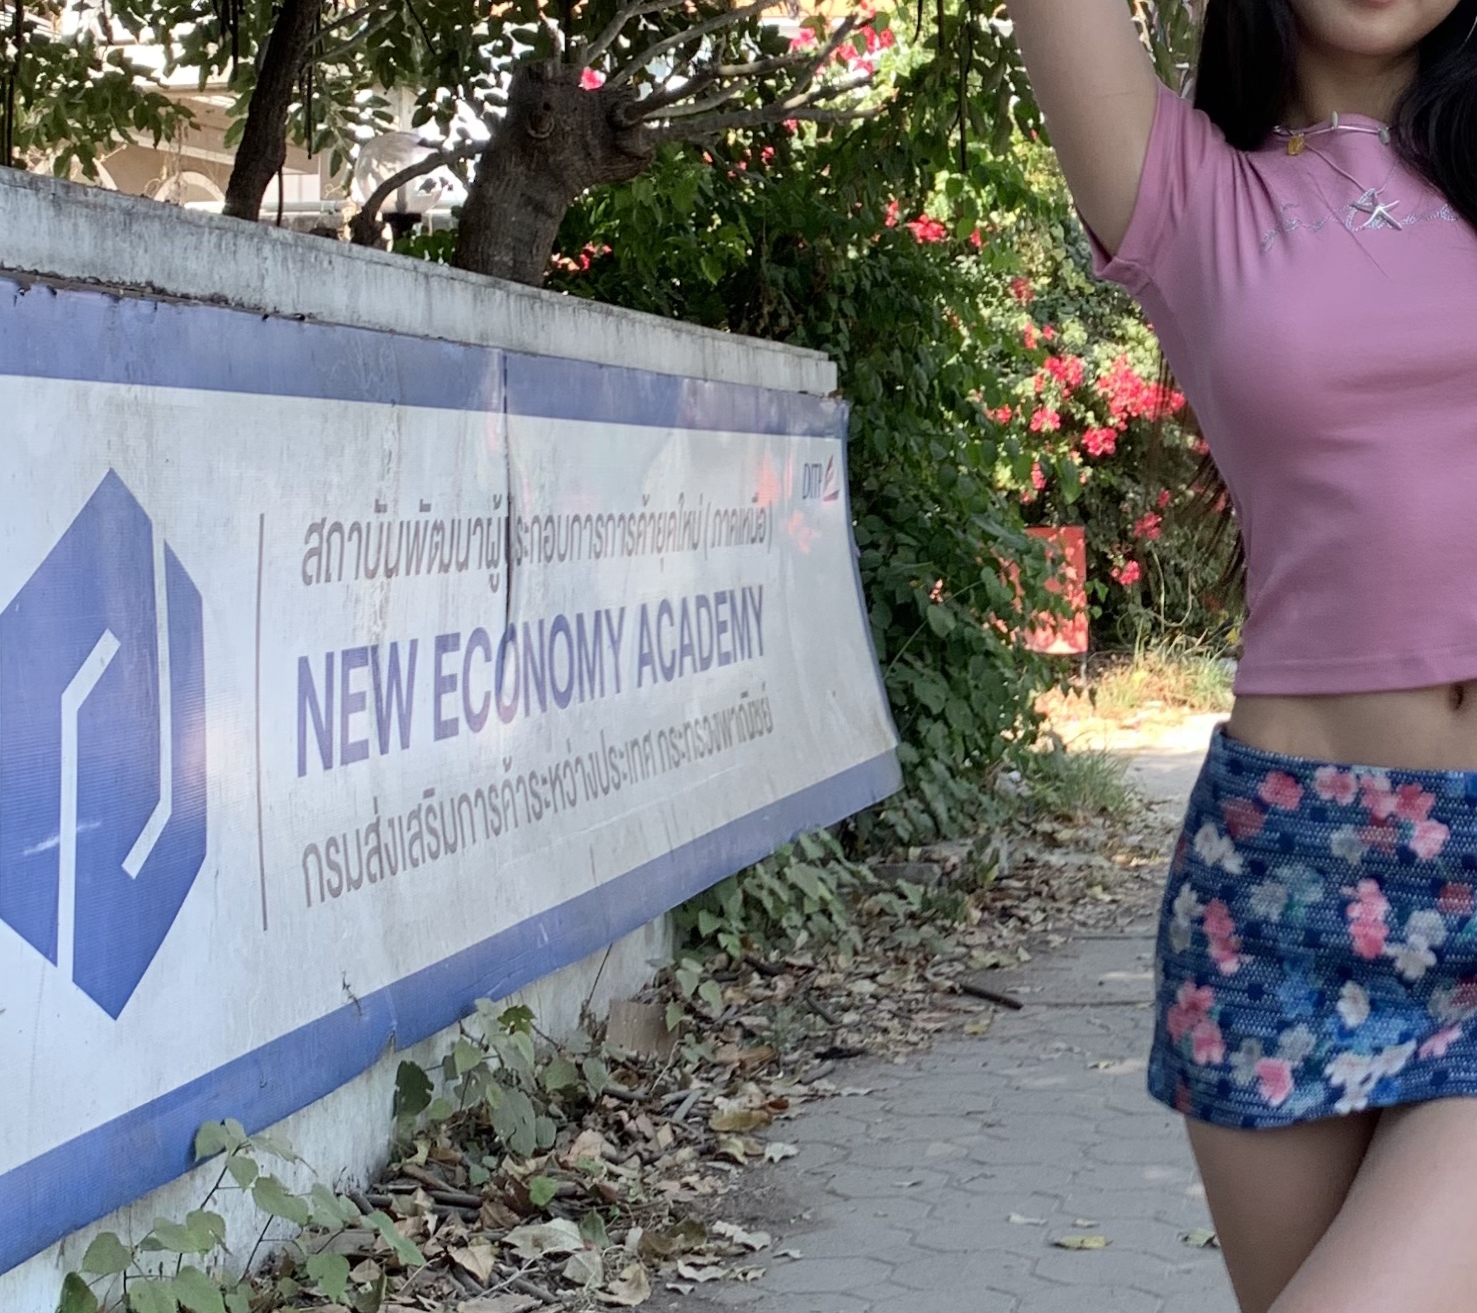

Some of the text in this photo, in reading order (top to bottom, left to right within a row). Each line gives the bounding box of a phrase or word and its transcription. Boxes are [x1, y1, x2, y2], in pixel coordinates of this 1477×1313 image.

[297, 584, 764, 777] NEW ECONOMY ACADEMY
[301, 728, 657, 908] กรมส่งเสริมการค้าระหว่างประเทศ
